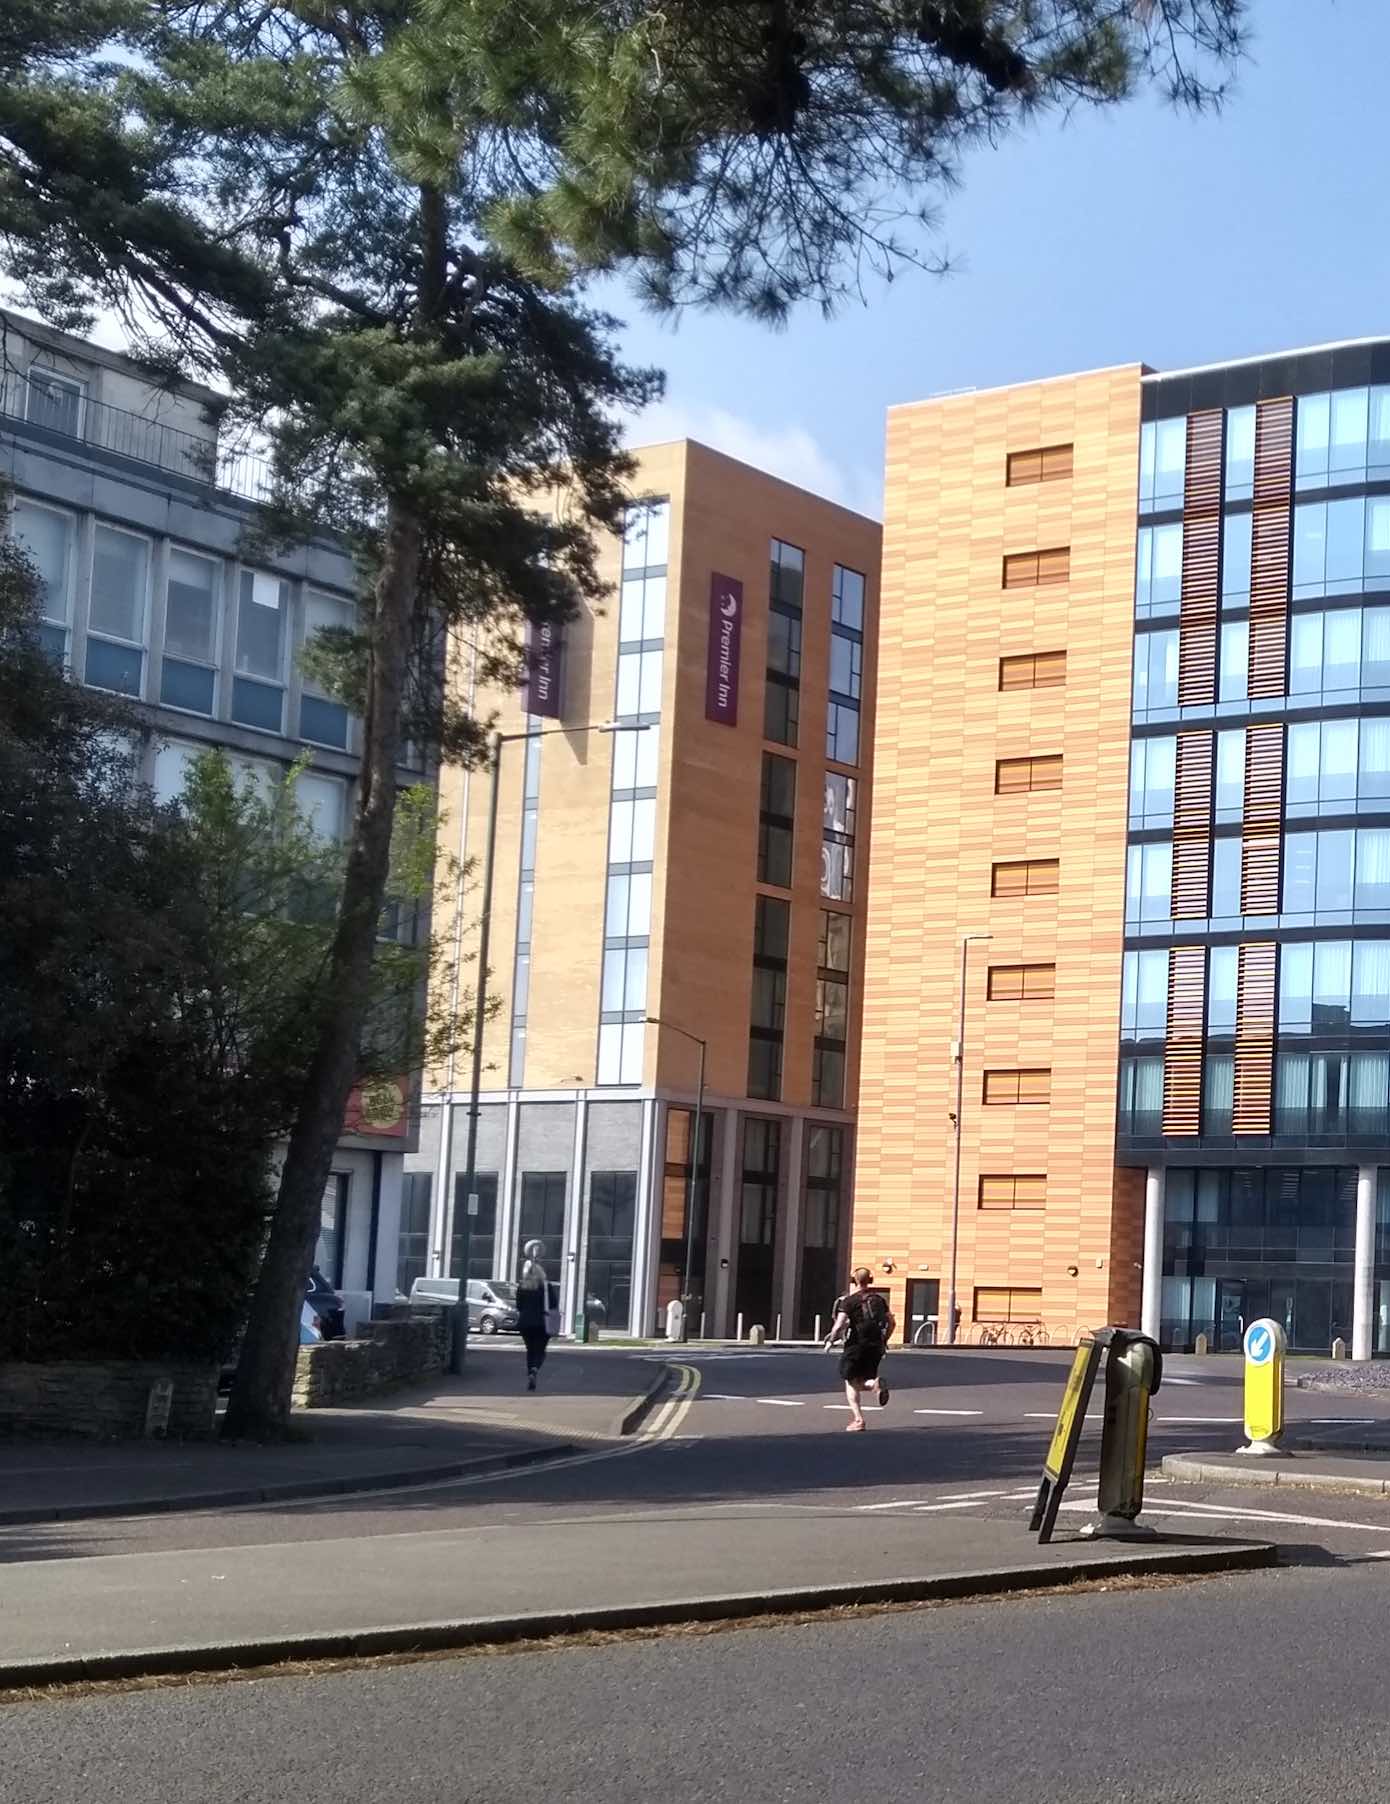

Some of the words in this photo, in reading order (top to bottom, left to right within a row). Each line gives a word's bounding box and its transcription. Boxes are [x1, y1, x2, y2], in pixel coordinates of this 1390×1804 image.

[719, 619, 733, 682] Premier
[538, 675, 552, 700] Inn
[718, 683, 731, 707] Inn
